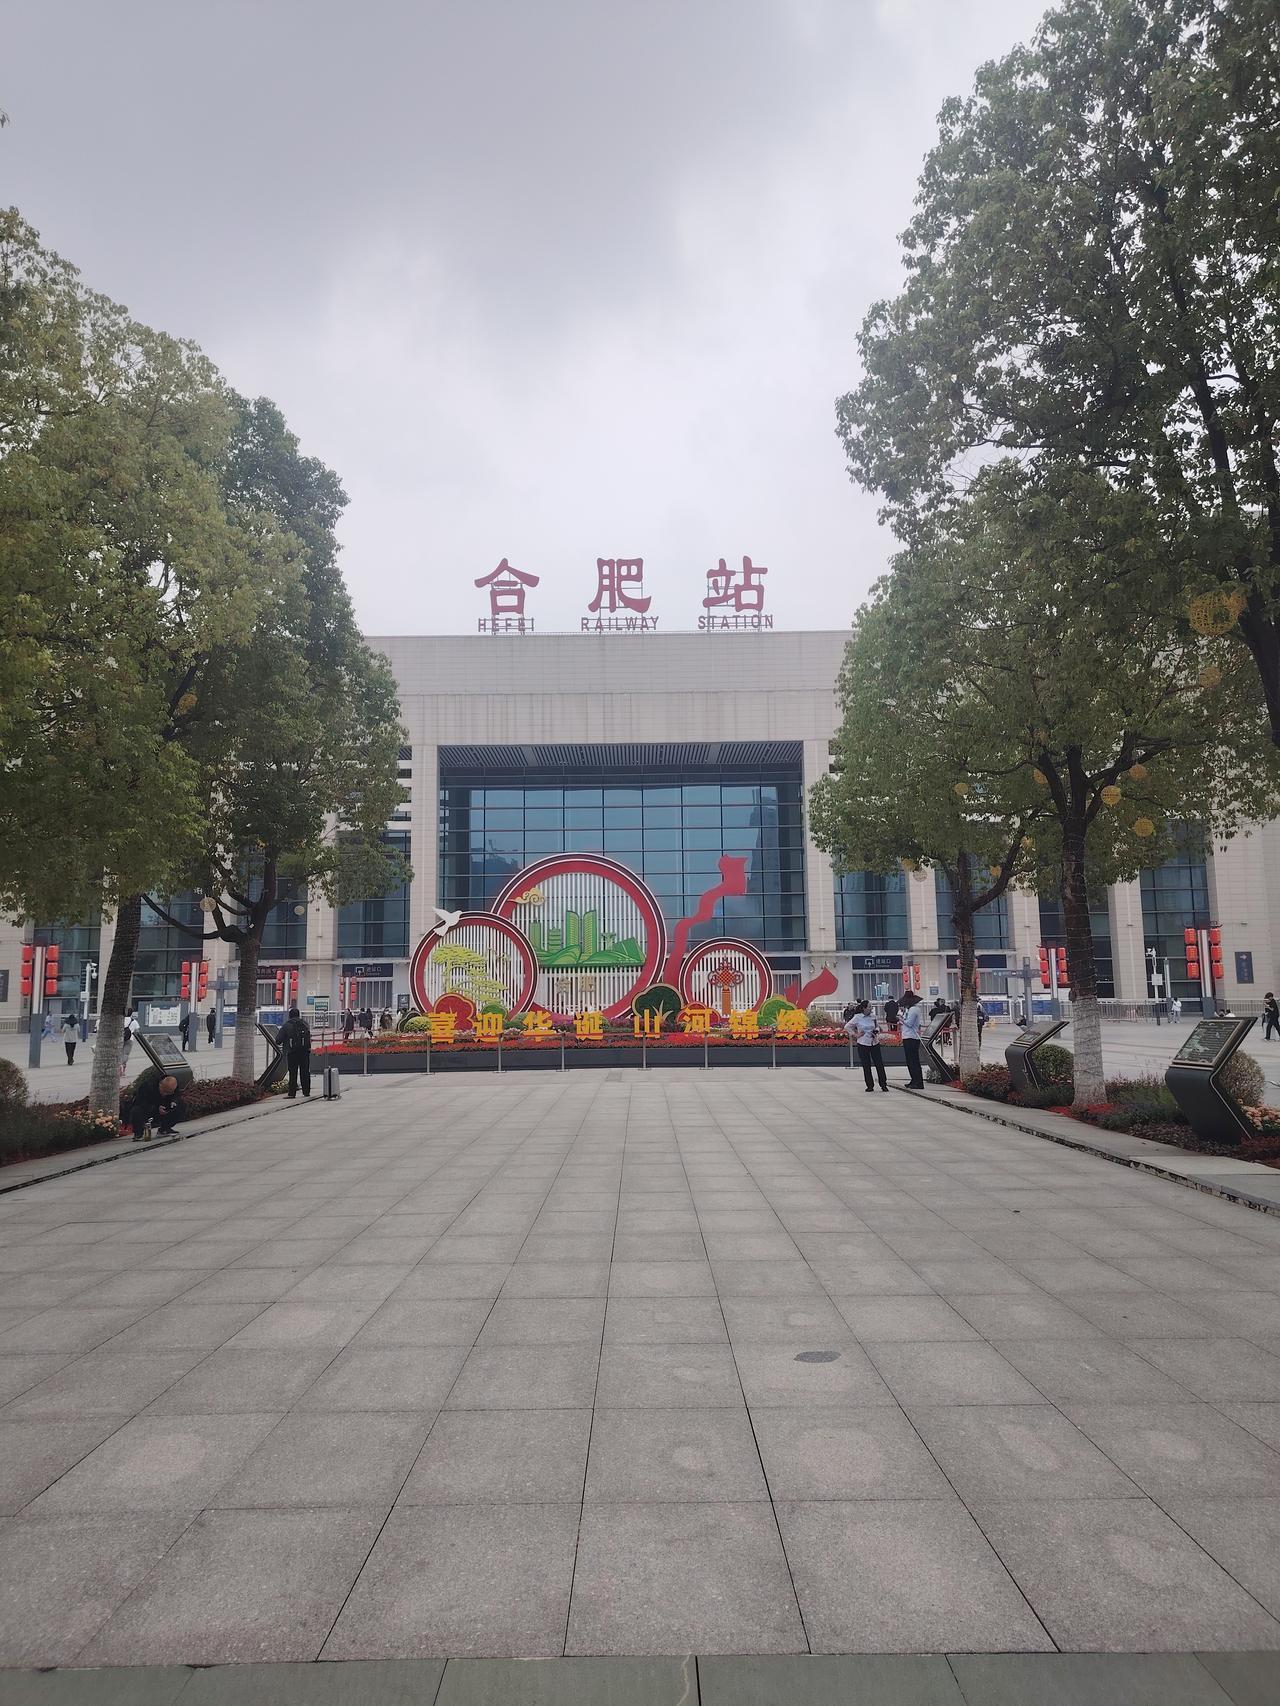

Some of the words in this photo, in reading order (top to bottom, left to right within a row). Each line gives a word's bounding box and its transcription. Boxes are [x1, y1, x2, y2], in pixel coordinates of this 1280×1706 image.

[474, 556, 768, 613] 合肥站
[478, 617, 535, 632] HEFEI
[581, 616, 659, 631] RAILWAY
[697, 614, 774, 630] STATION
